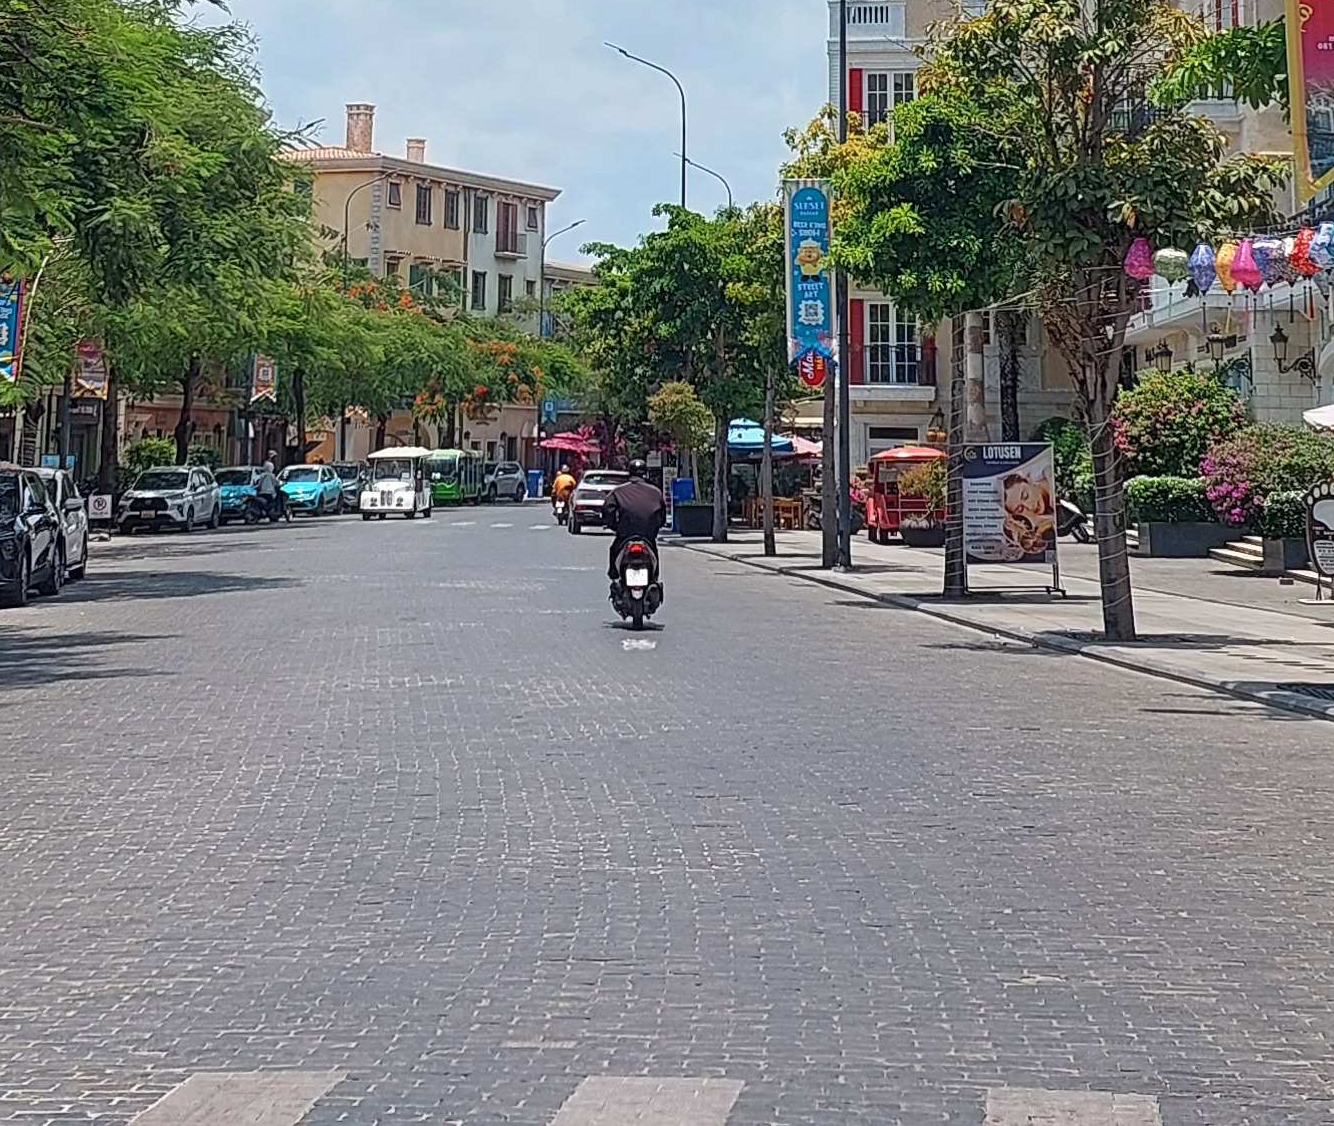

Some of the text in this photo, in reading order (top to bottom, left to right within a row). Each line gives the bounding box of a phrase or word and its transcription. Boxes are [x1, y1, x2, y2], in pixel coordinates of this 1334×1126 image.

[1317, 42, 1332, 50] 081
[797, 282, 824, 292] STREET
[804, 290, 818, 298] ART
[982, 446, 1022, 459] LOTUSEN
